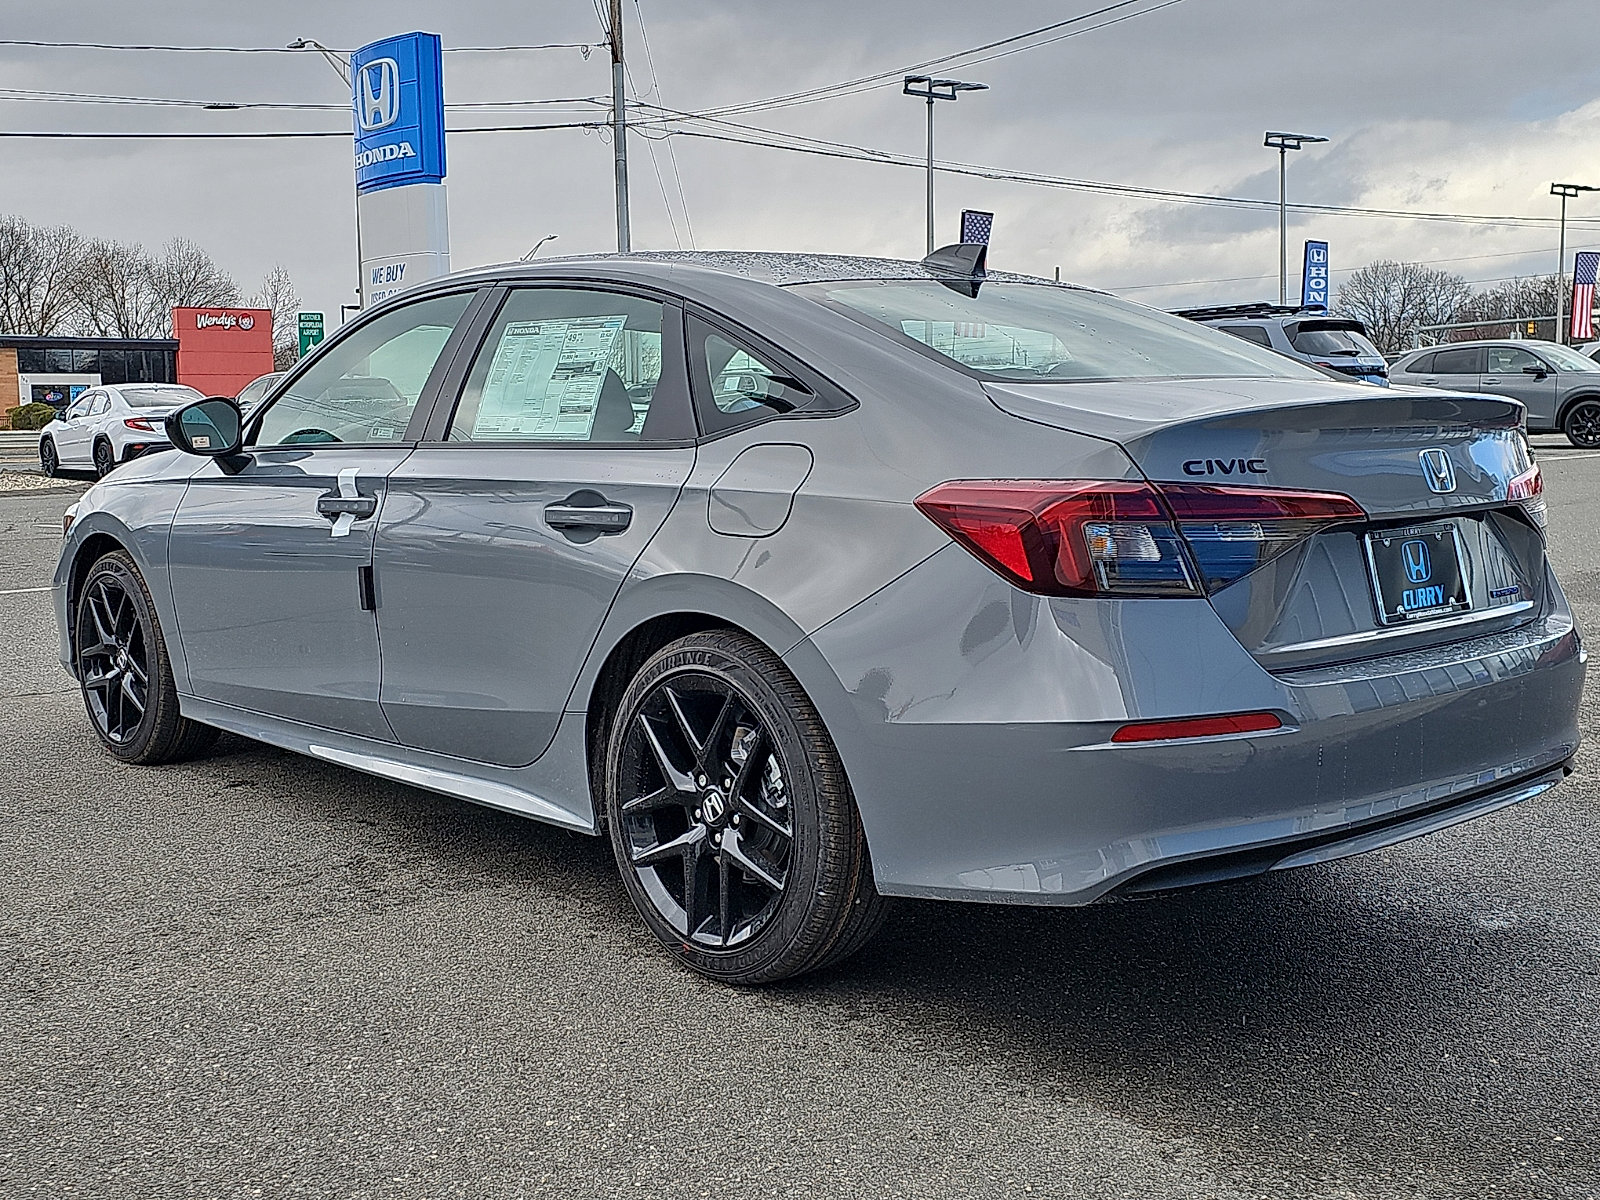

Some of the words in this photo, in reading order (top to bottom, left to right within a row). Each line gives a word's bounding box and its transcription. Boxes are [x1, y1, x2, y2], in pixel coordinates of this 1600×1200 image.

[355, 142, 416, 169] HONDA
[372, 266, 384, 284] WE
[386, 262, 406, 282] BUY
[1308, 266, 1328, 306] HON
[196, 311, 237, 329] Wendy's
[1182, 458, 1268, 475] CIVIC
[1403, 584, 1444, 610] CURRY
